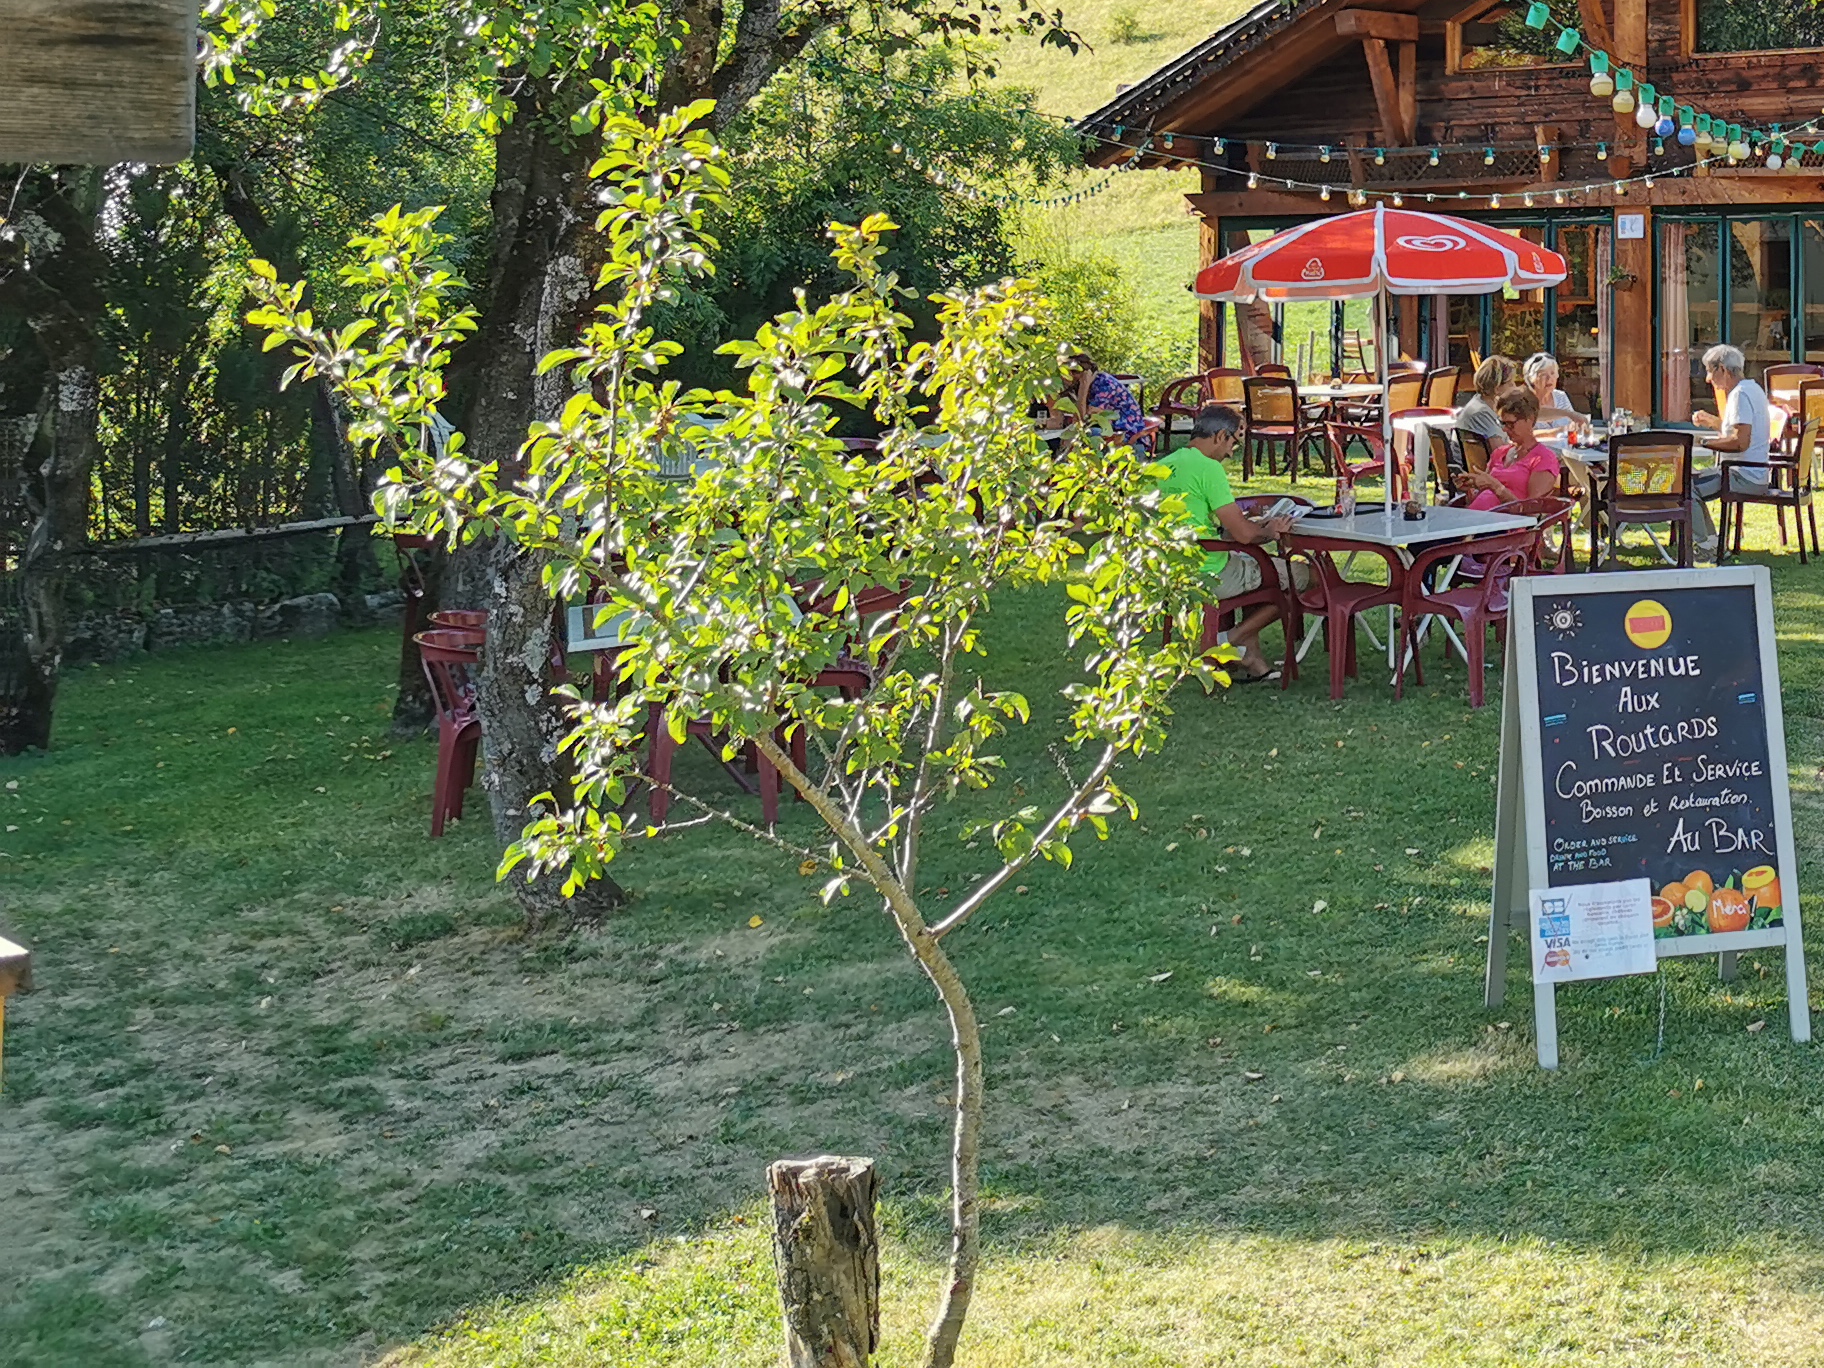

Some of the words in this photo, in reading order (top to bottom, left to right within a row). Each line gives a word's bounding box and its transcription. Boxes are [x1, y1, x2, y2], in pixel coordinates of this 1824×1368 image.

[1580, 798, 1634, 823] Boisson
[1643, 799, 1660, 817] et
[1704, 817, 1774, 856] BAR
[1552, 861, 1564, 872] AT
[1567, 860, 1585, 871] THE
[1588, 858, 1612, 870] BAR
[1544, 937, 1571, 950] VISA
